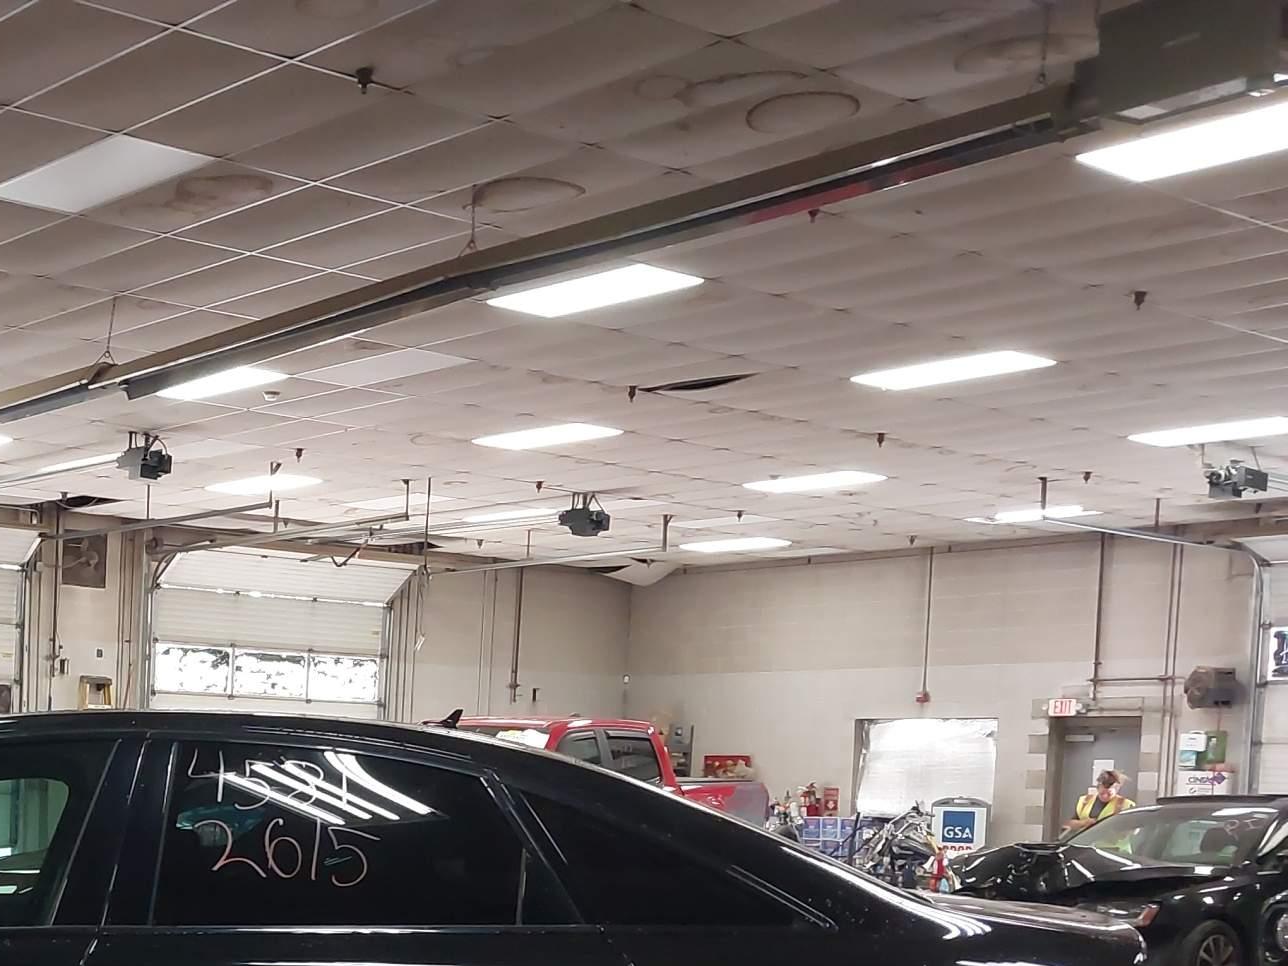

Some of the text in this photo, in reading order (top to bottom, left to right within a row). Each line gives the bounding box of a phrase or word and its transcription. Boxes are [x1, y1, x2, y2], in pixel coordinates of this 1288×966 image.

[1054, 700, 1072, 714] EXIT
[944, 826, 973, 838] GSA
[194, 816, 382, 888] 2615
